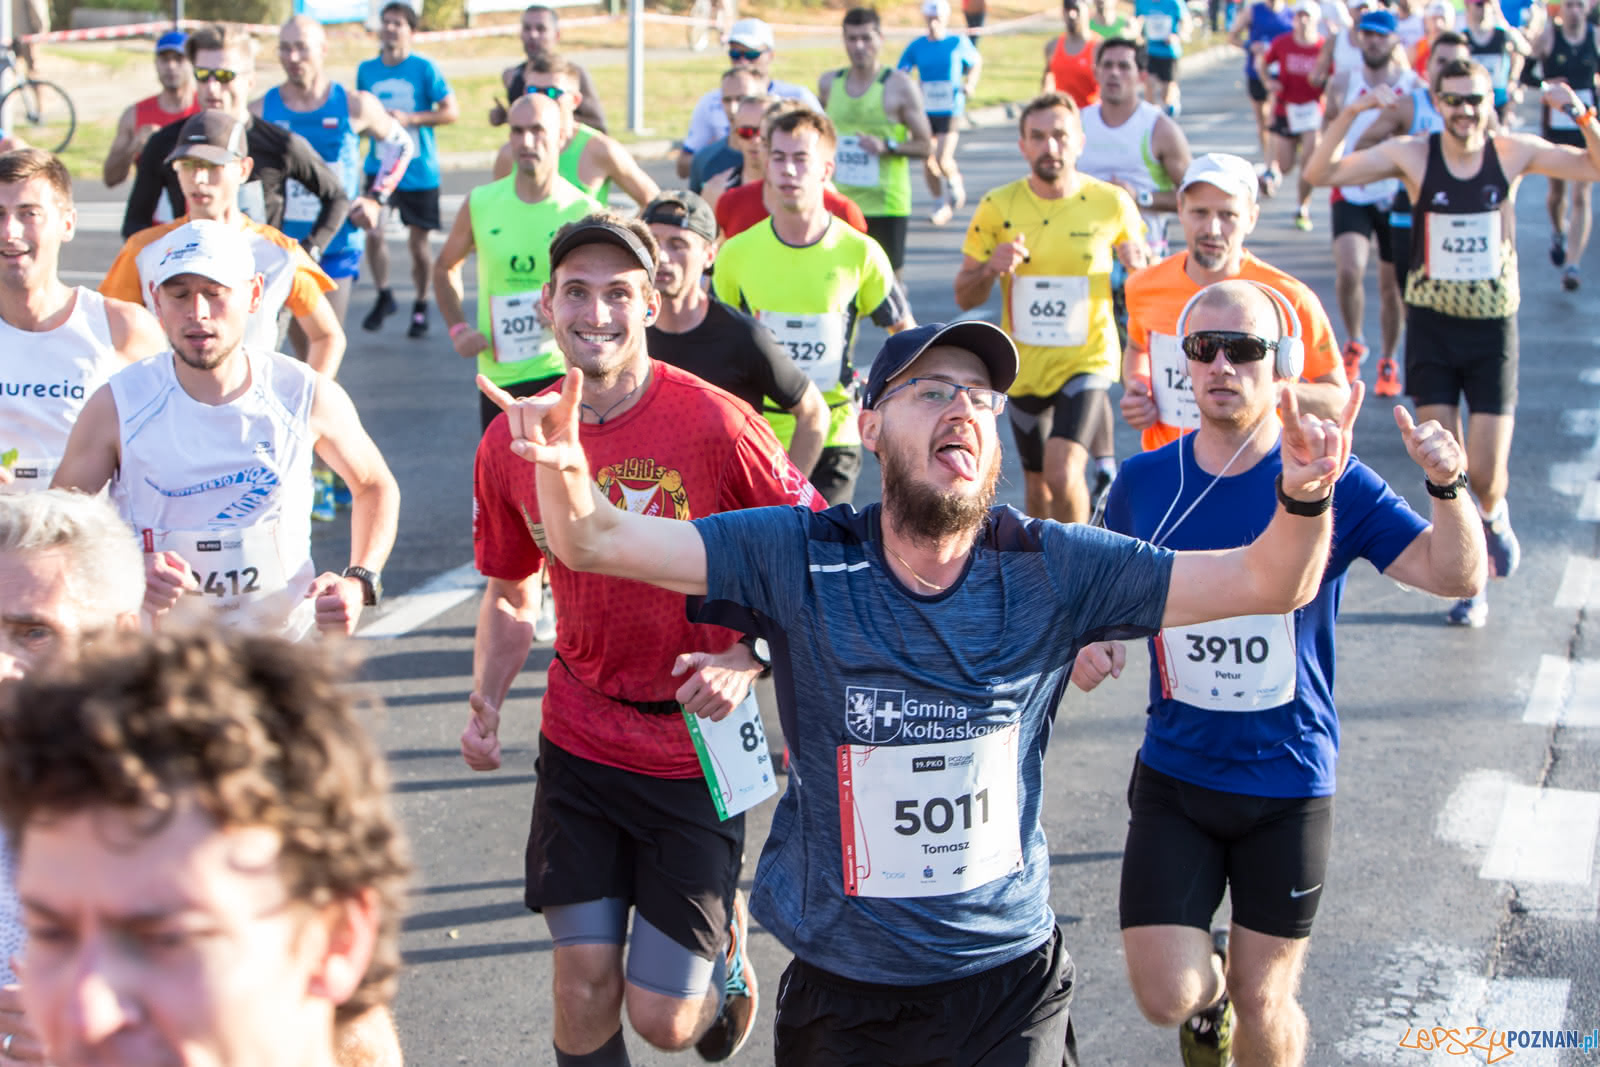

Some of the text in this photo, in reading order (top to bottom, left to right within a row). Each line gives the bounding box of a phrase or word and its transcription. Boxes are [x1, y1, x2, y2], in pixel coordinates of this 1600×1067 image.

[1442, 237, 1489, 253] 4223
[1029, 300, 1067, 317] 662
[775, 341, 826, 360] 329
[623, 456, 656, 479] 1910
[1186, 634, 1269, 664] 3910
[1215, 670, 1241, 680] Petur
[904, 699, 968, 719] Gmina
[893, 788, 989, 836] 5011
[921, 841, 970, 855] Tomasz
